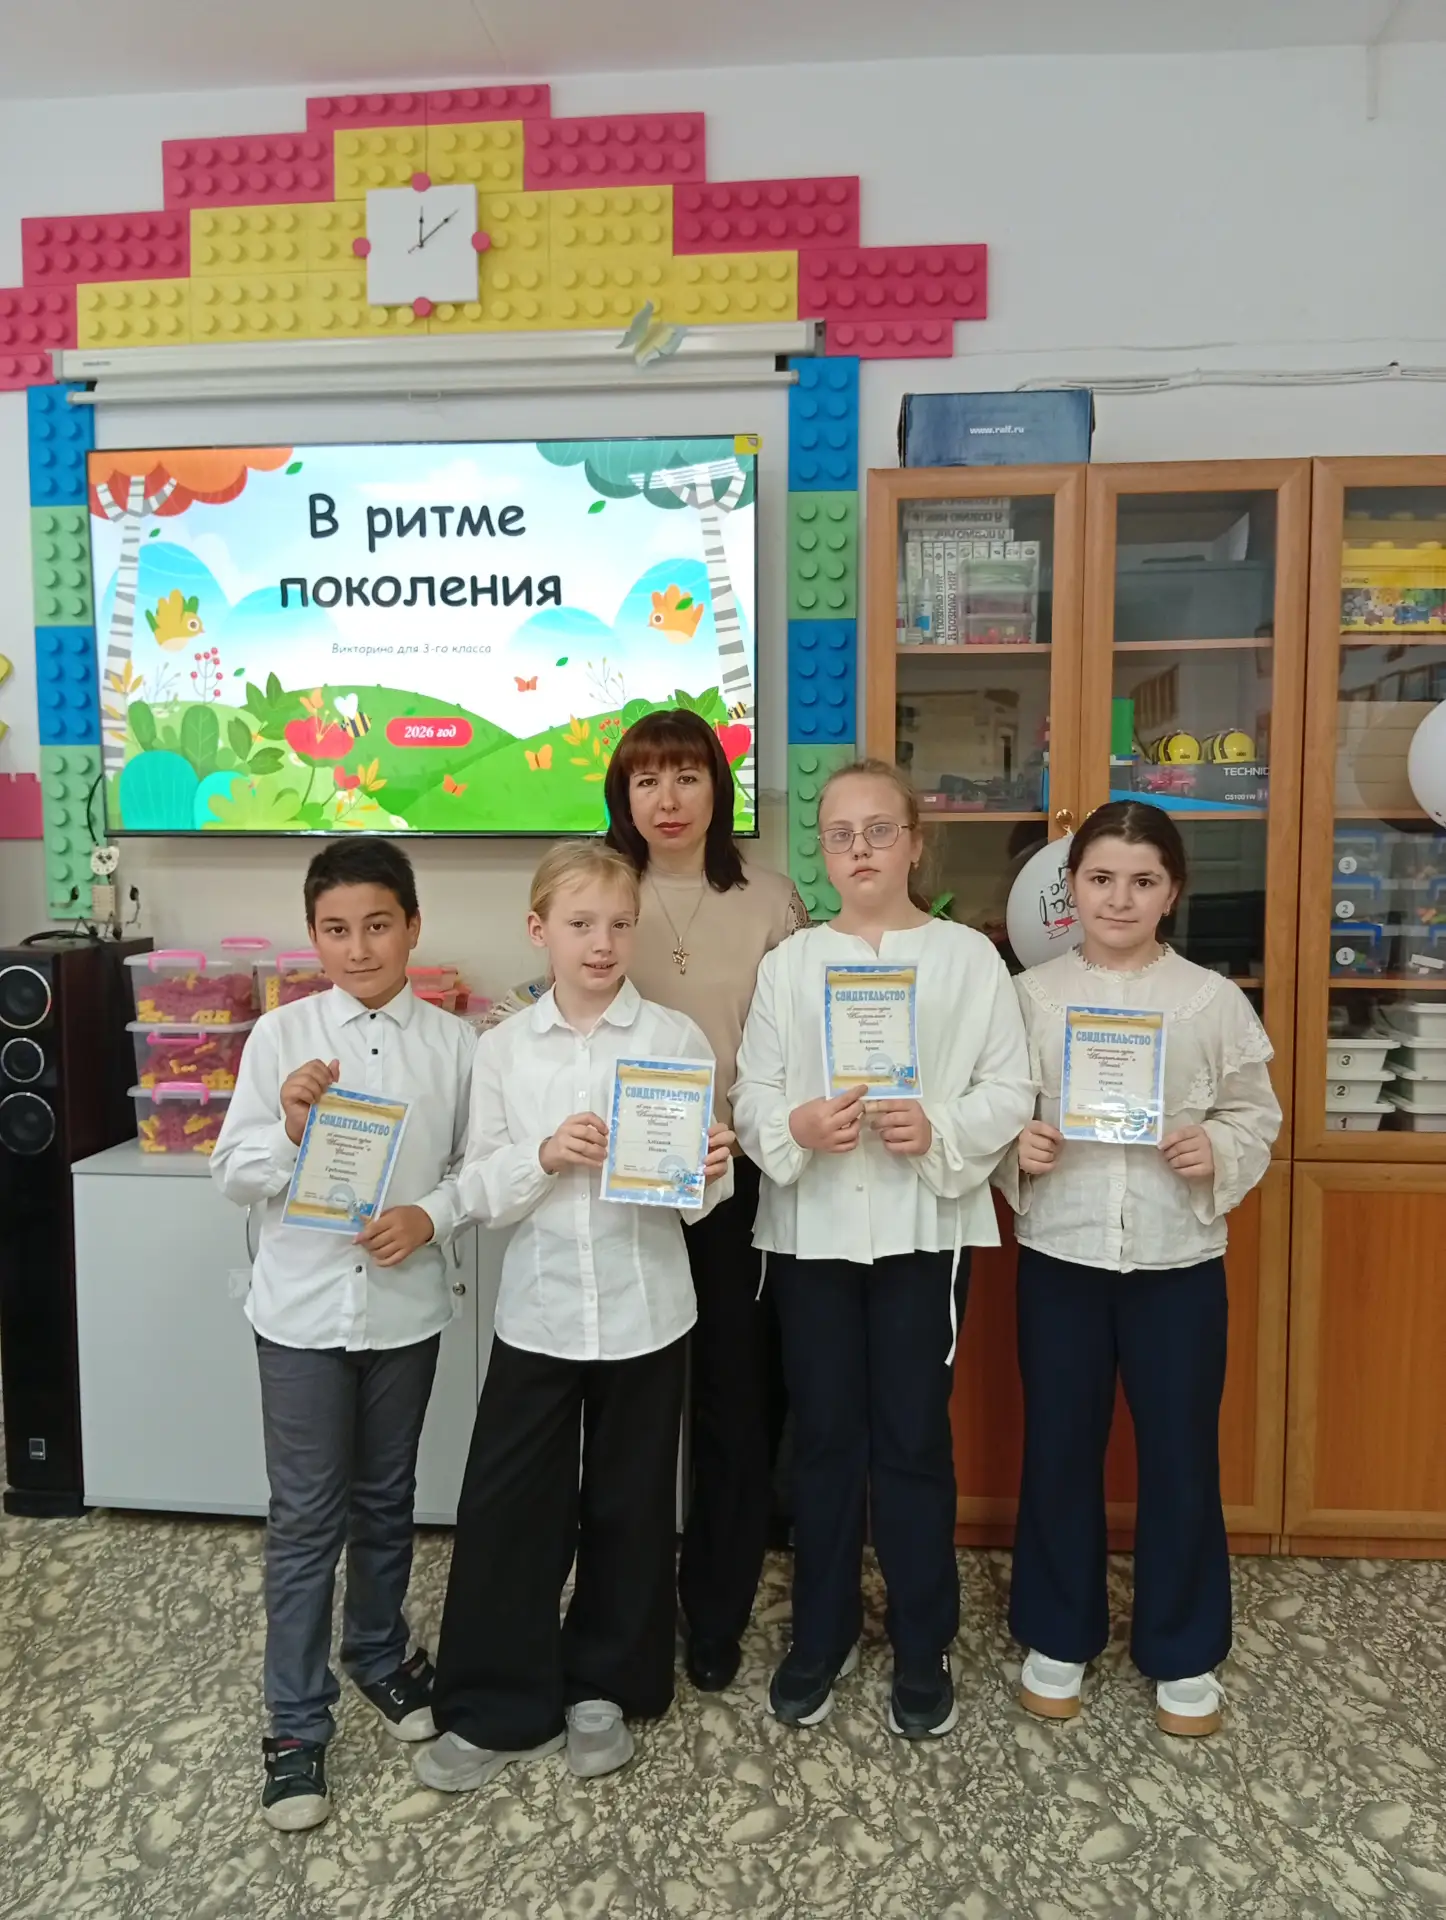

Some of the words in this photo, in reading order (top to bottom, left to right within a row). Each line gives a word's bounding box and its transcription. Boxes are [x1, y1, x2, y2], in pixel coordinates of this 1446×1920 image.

[308, 492, 339, 539] В
[366, 504, 527, 553] ритме
[279, 573, 562, 608] поколения
[397, 644, 419, 654] для
[423, 643, 449, 654] 3-го
[452, 644, 492, 654] класса
[404, 725, 434, 739] 2026
[436, 724, 457, 738] год
[1223, 767, 1269, 776] TECHNIC
[1344, 860, 1351, 870] 3
[1341, 904, 1349, 914] 2
[1342, 951, 1349, 961] 1
[835, 990, 906, 1002] СВИДЕТЕЛЬСТВО
[1075, 1030, 1151, 1046] СВИДЕТЕЛЬСТВО
[1341, 1054, 1351, 1066] 3
[1336, 1085, 1346, 1097] 2
[319, 1112, 391, 1137] СВИДЕТЕЛЬСТВО
[1340, 1117, 1348, 1129] 1
